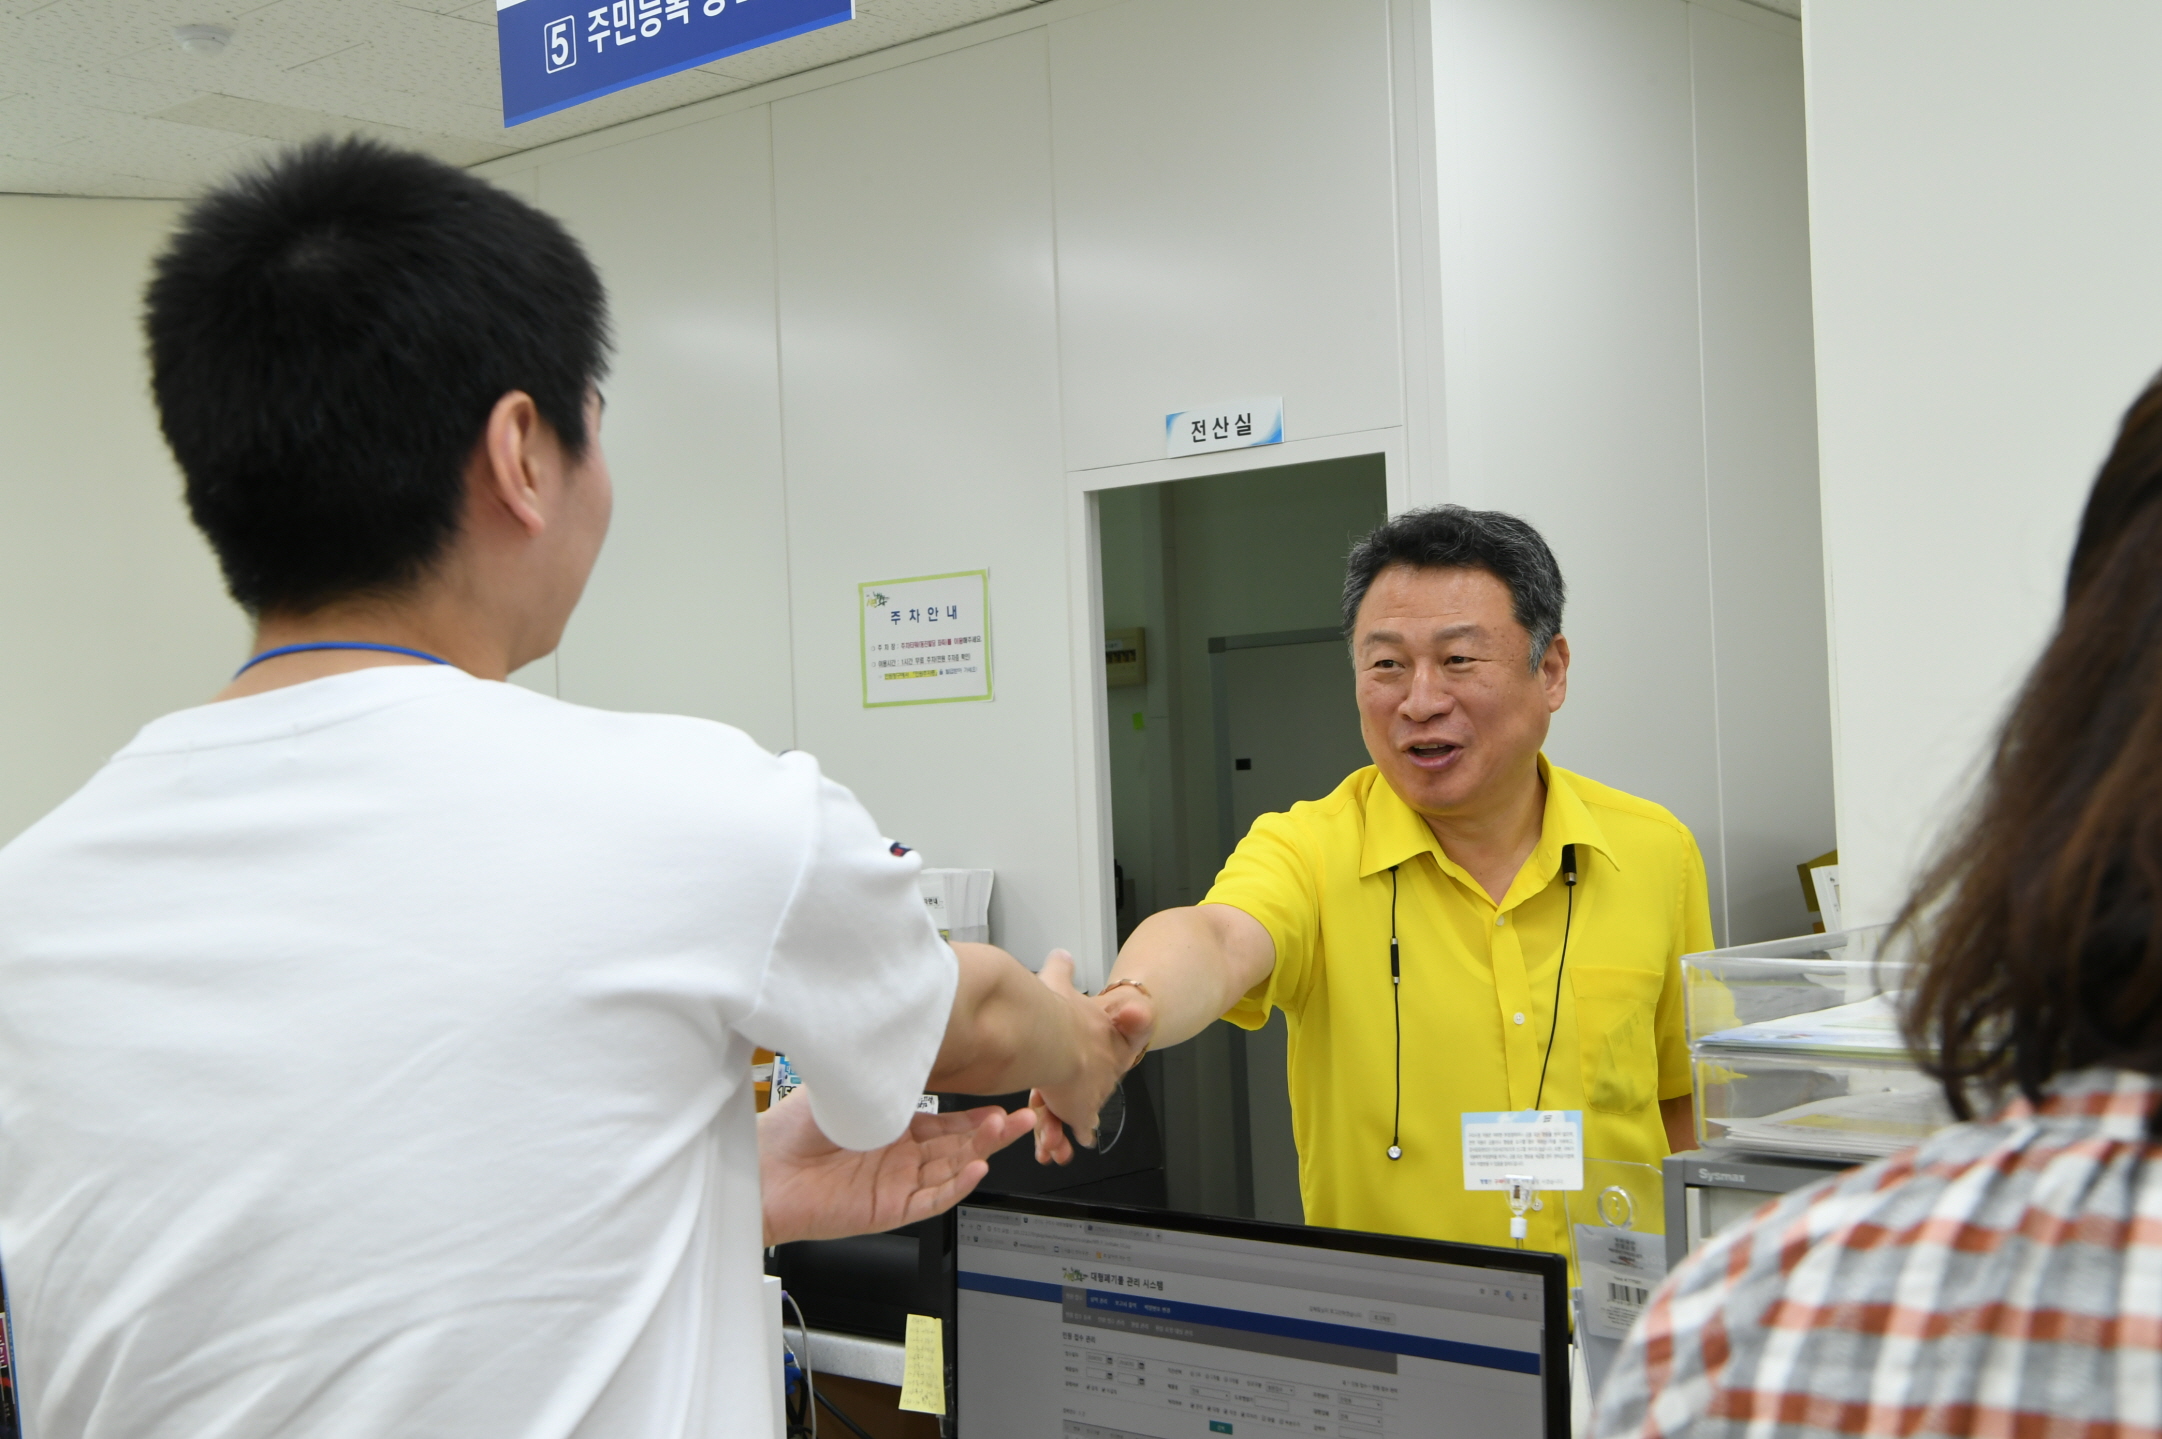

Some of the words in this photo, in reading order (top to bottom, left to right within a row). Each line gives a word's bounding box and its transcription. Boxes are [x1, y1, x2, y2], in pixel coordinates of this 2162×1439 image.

[551, 23, 569, 65] 5
[1191, 412, 1252, 443] 전산실
[1698, 1167, 1747, 1183] Sysmax
[1090, 1271, 1124, 1287] 대형폐기물
[1126, 1276, 1142, 1288] 관리
[1143, 1278, 1164, 1291] 시스템
